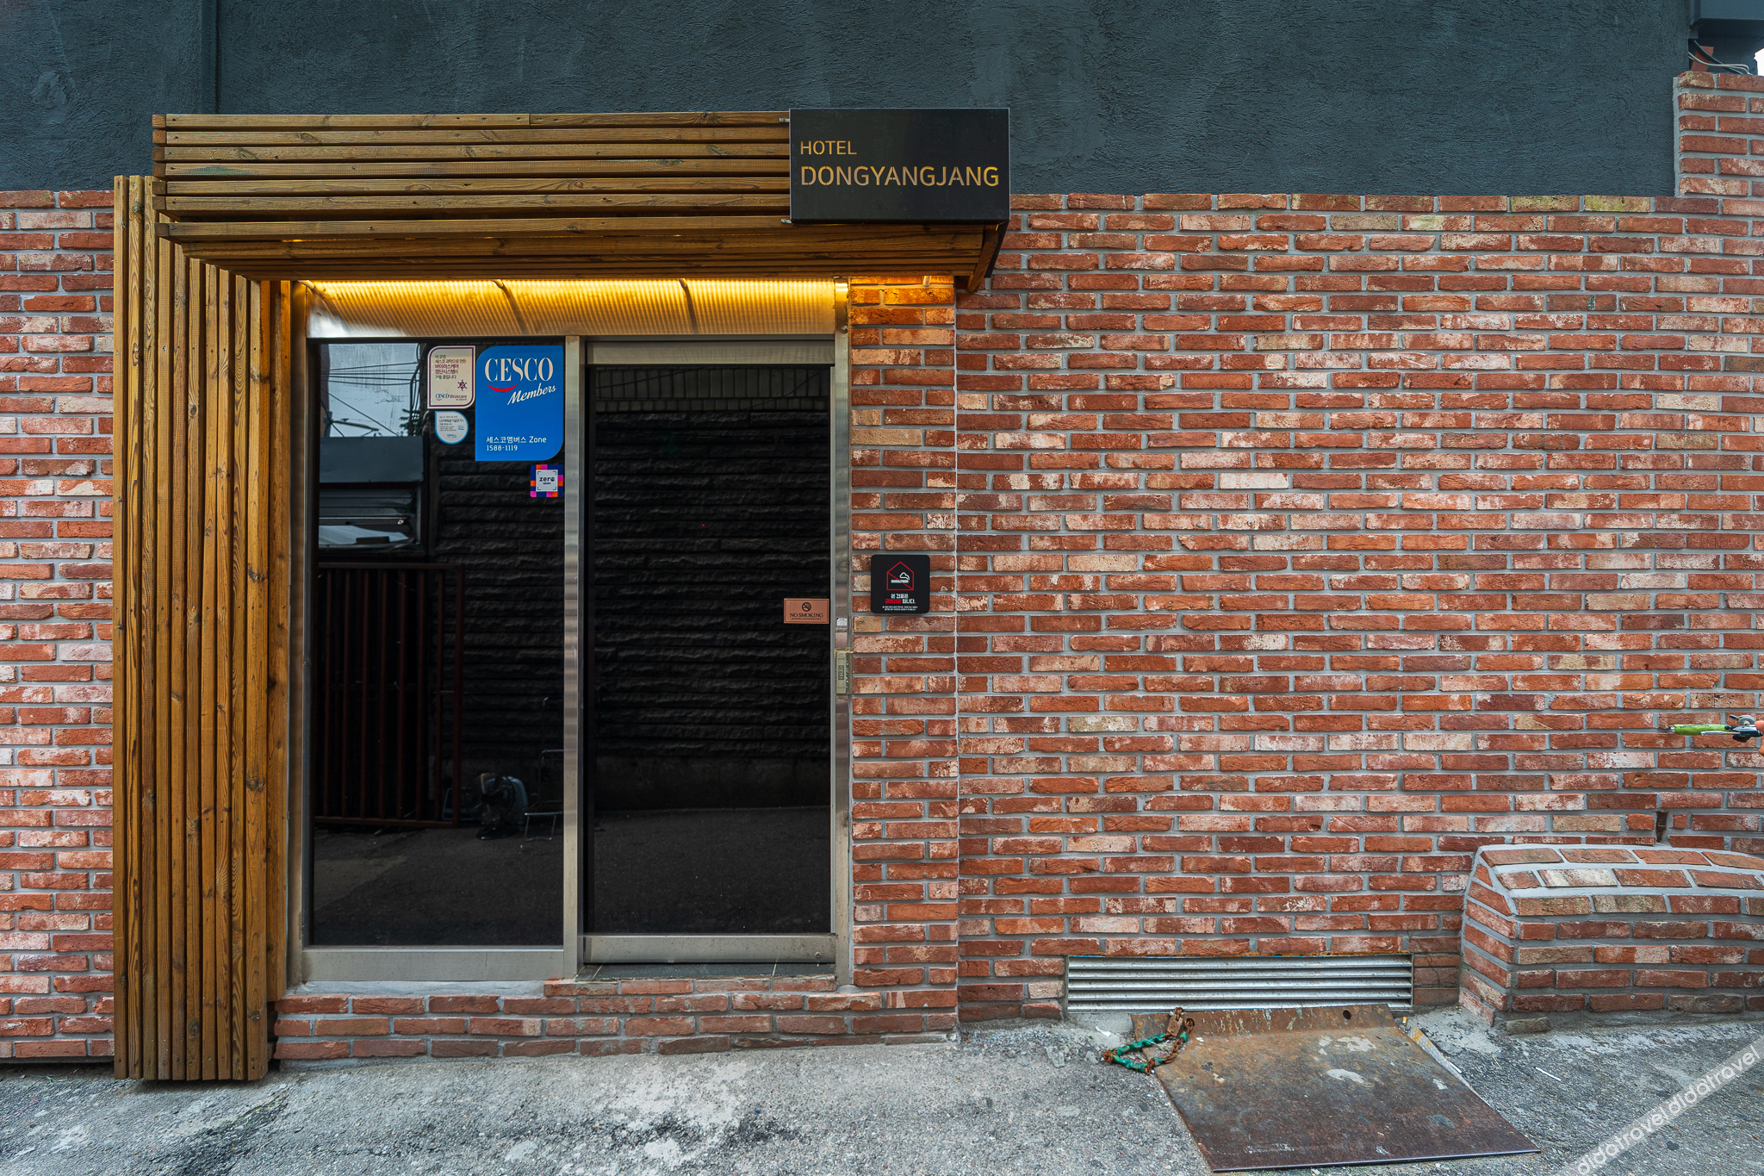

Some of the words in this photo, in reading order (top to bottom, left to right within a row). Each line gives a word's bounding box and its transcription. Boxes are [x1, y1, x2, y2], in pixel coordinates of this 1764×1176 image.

[800, 140, 857, 155] HOTEL
[801, 166, 999, 186] DONGYANGJANG
[484, 357, 554, 382] CESCO
[507, 382, 557, 406] Members
[486, 436, 527, 444] 세스코멤버스
